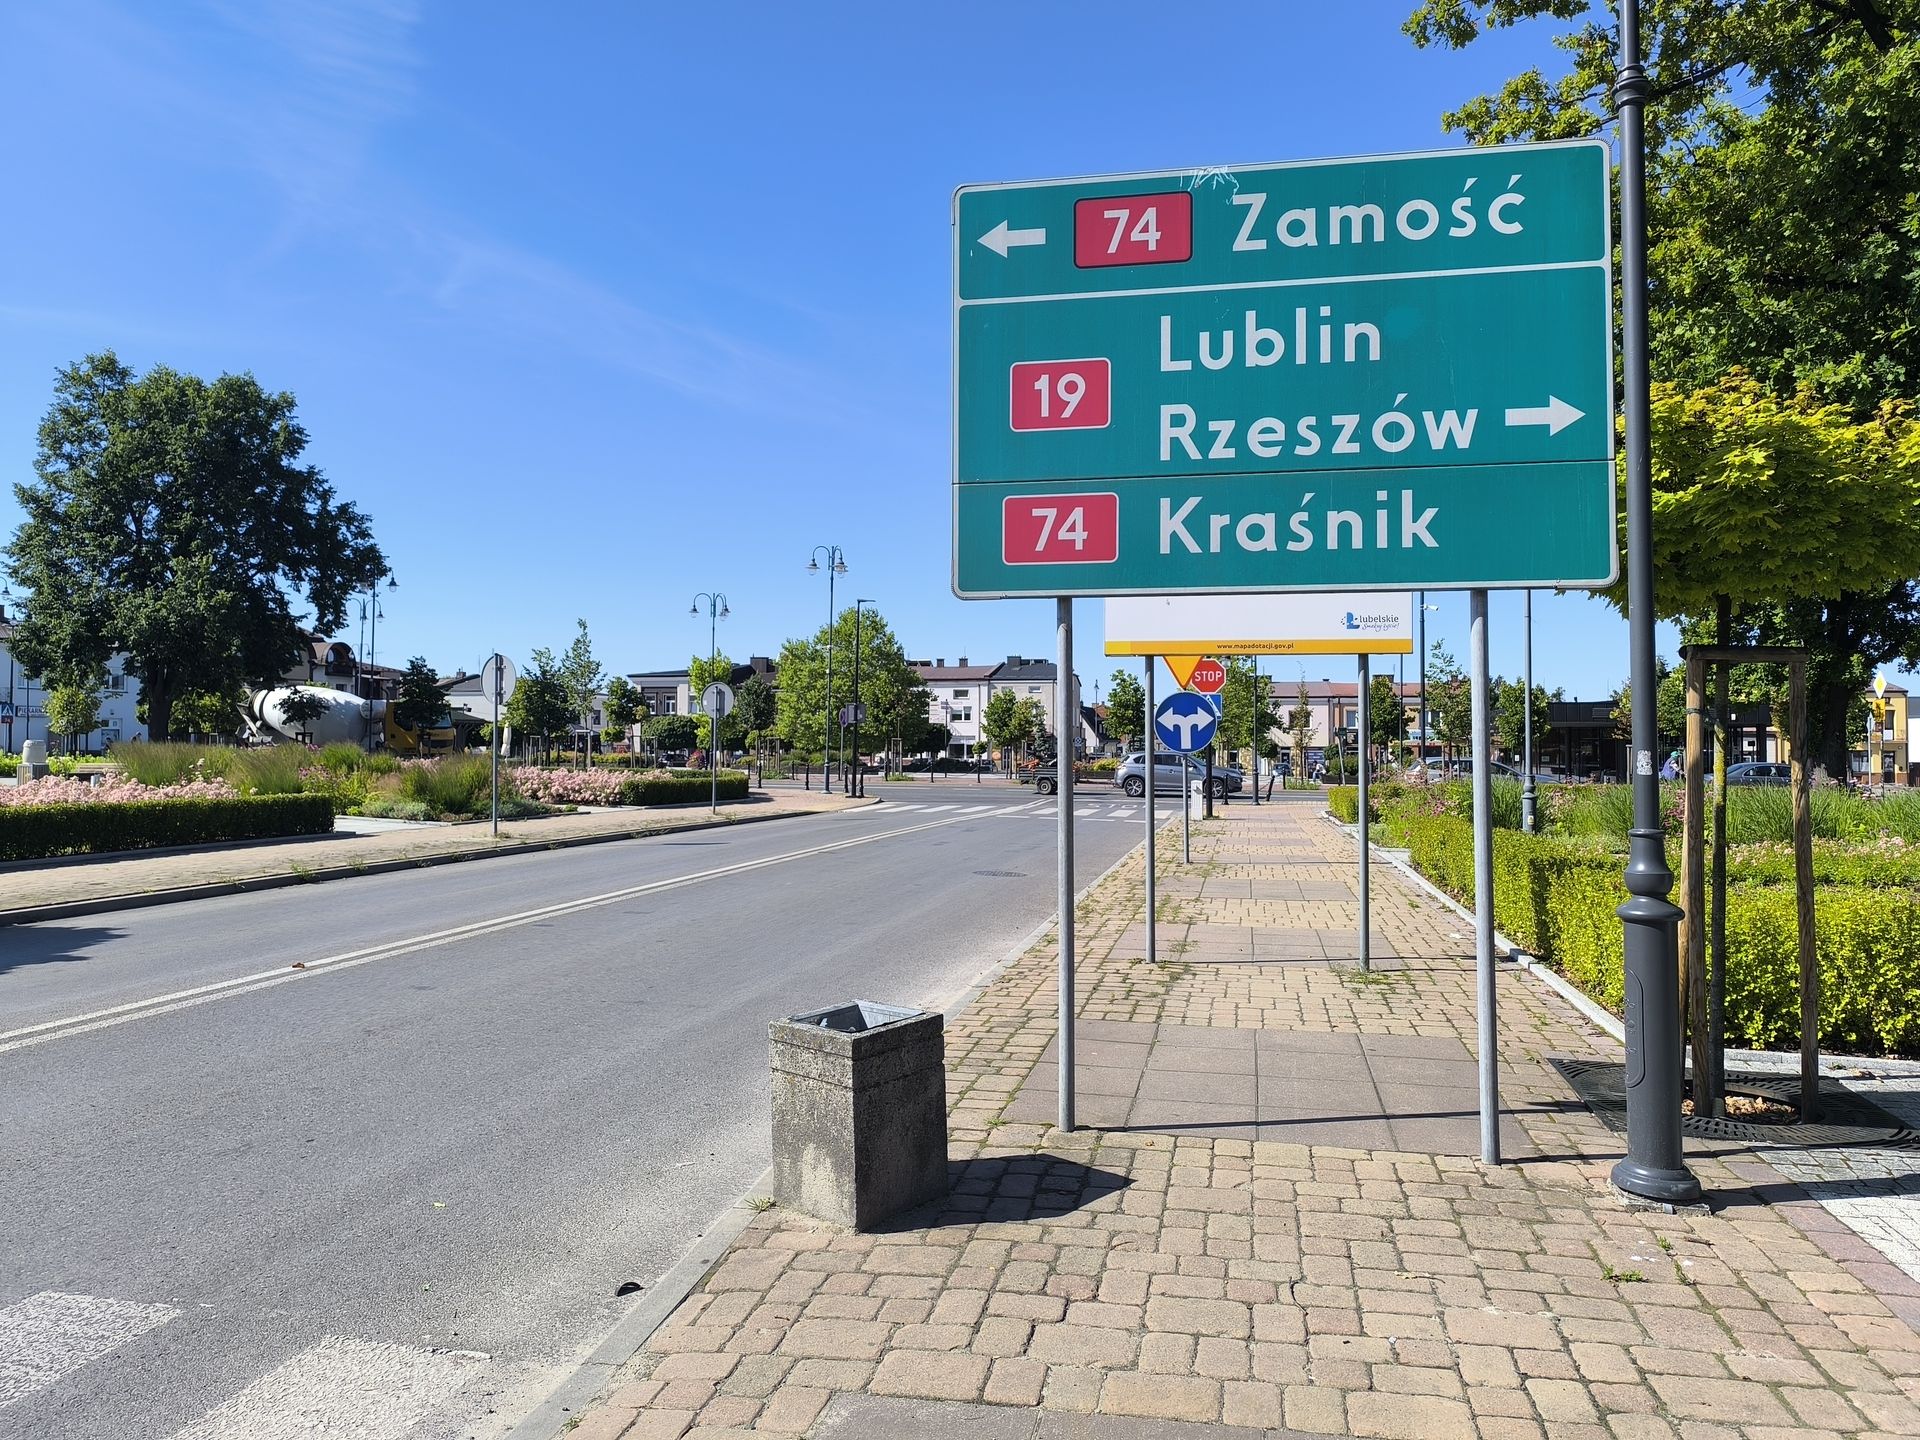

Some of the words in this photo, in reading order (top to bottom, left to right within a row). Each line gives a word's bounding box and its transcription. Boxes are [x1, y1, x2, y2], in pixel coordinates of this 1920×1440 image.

[1103, 207, 1162, 254] 74
[1231, 174, 1525, 252] Zamość
[1160, 305, 1381, 372] Lublin
[1034, 373, 1087, 418] 19
[1160, 393, 1479, 461] Rzeszów
[1031, 507, 1089, 552] 74
[1160, 488, 1440, 554] Kraśnik
[1359, 615, 1398, 623] lubelskie
[1194, 671, 1222, 682] STOP
